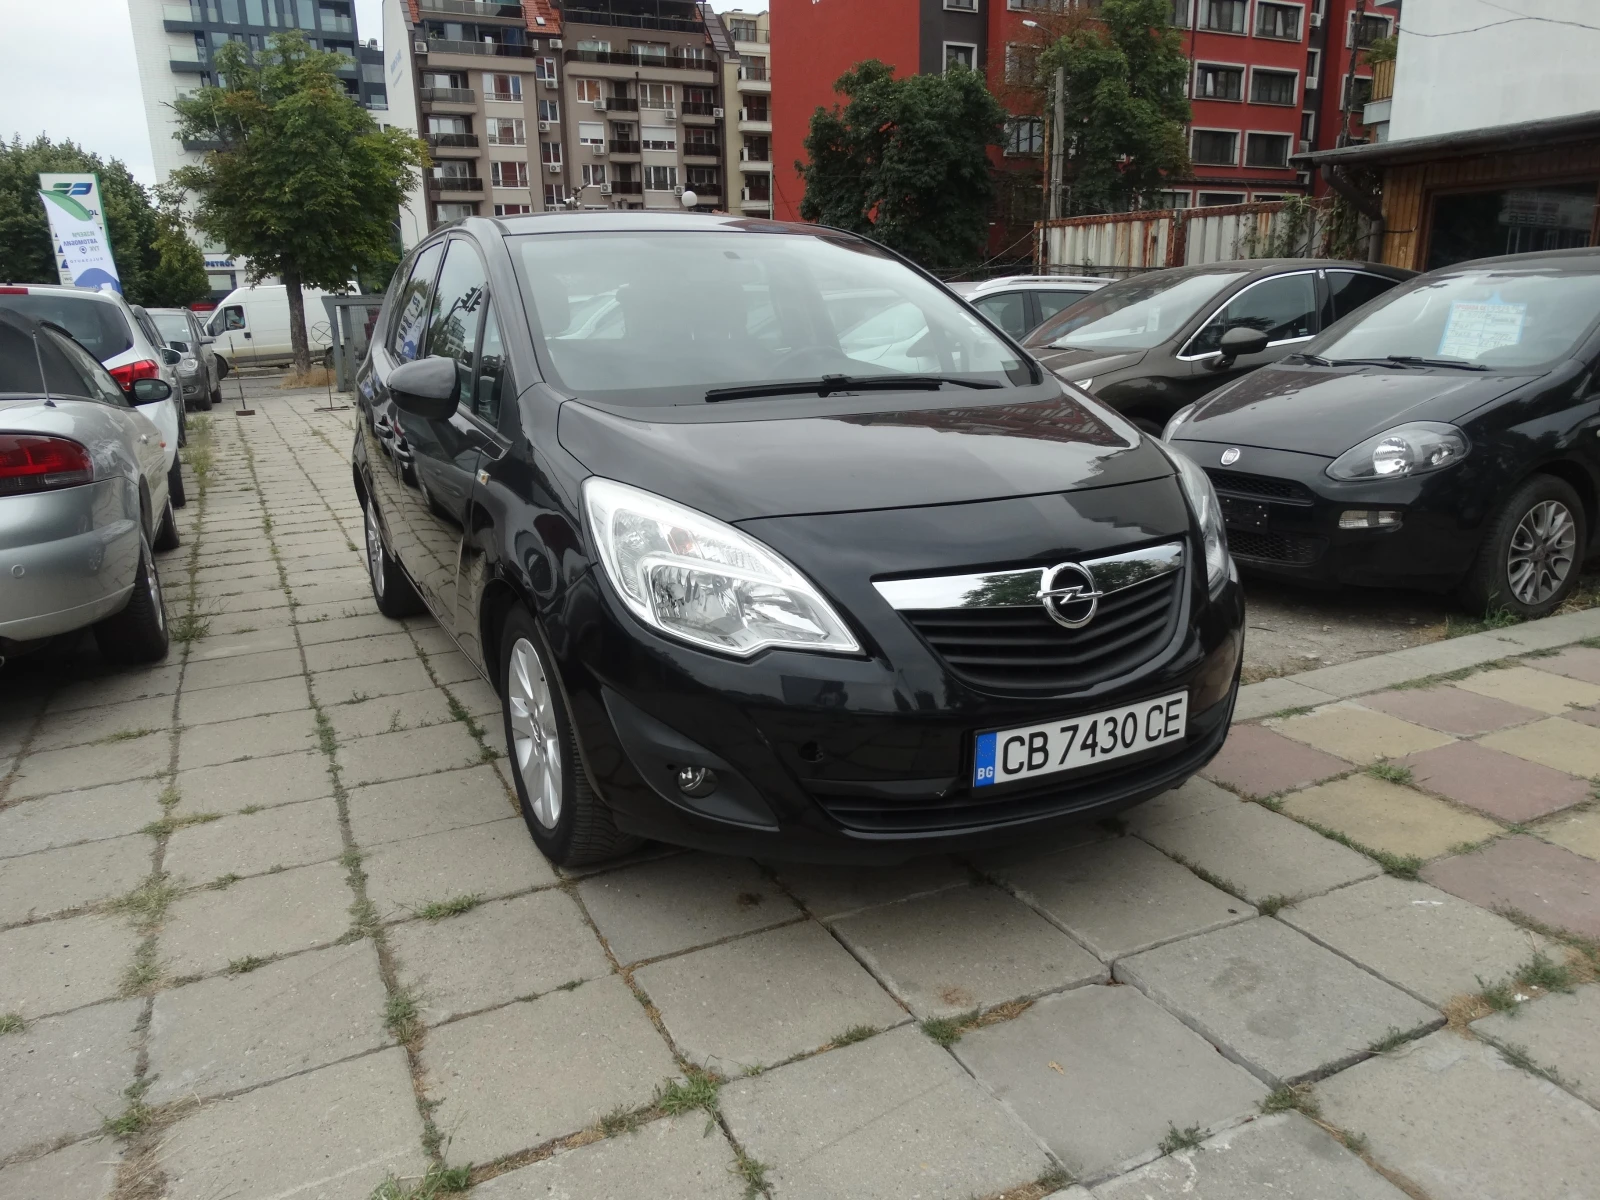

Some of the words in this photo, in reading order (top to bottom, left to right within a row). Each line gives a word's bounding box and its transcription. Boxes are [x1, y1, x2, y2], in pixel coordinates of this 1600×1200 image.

[1001, 731, 1049, 775] CB
[1058, 711, 1138, 766] 7430
[1145, 697, 1183, 742] CE
[977, 766, 994, 780] BG
